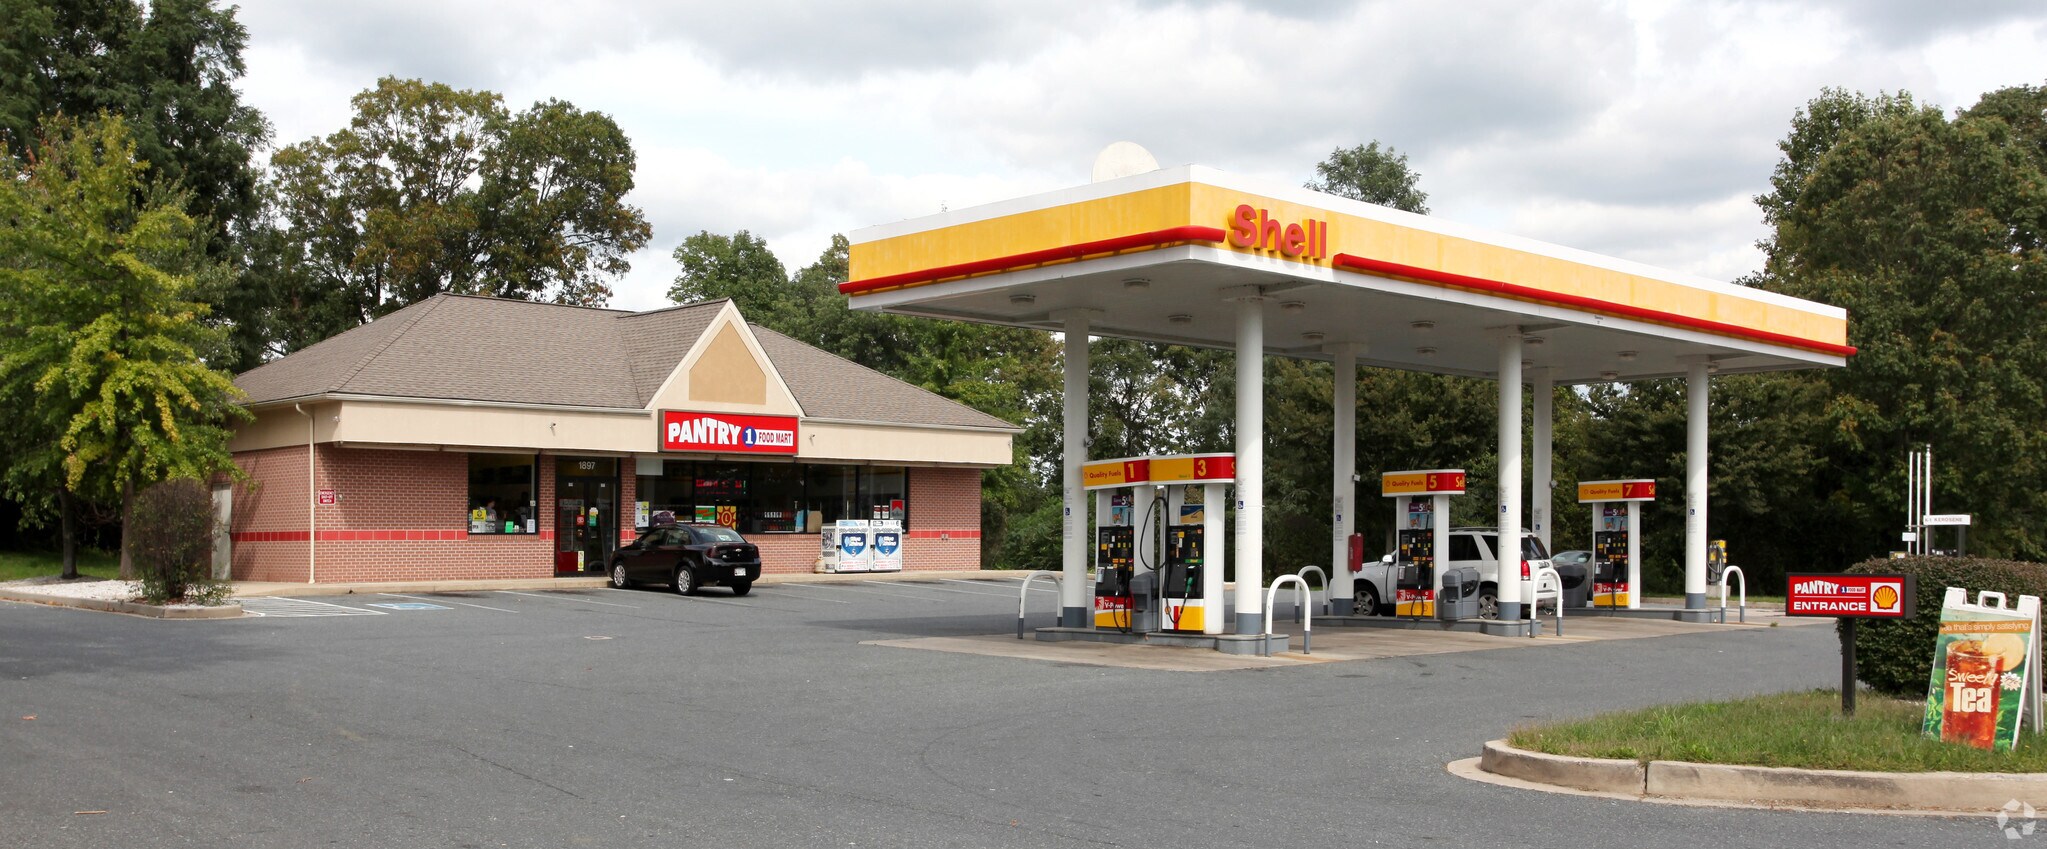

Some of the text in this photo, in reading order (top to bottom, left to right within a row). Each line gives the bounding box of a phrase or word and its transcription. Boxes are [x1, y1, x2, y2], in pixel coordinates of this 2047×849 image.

[1230, 204, 1327, 259] Shell
[668, 417, 792, 445] PANTRY 1 FOOD MART
[578, 461, 596, 470] 1897
[1128, 463, 1135, 479] 1
[1197, 459, 1207, 477] 3
[1089, 469, 1122, 479] Quality Fuels
[1391, 480, 1410, 488] Quality
[1429, 475, 1438, 489] 5
[1455, 476, 1465, 488] Sel
[1625, 484, 1634, 497] 7
[1794, 580, 1840, 595] PANTRY
[1793, 601, 1867, 611] ENTRANCE
[1953, 623, 1973, 631] that's
[1973, 623, 1996, 633] simply
[1996, 622, 2031, 633] satisfying.
[1950, 682, 1992, 713] Tea
